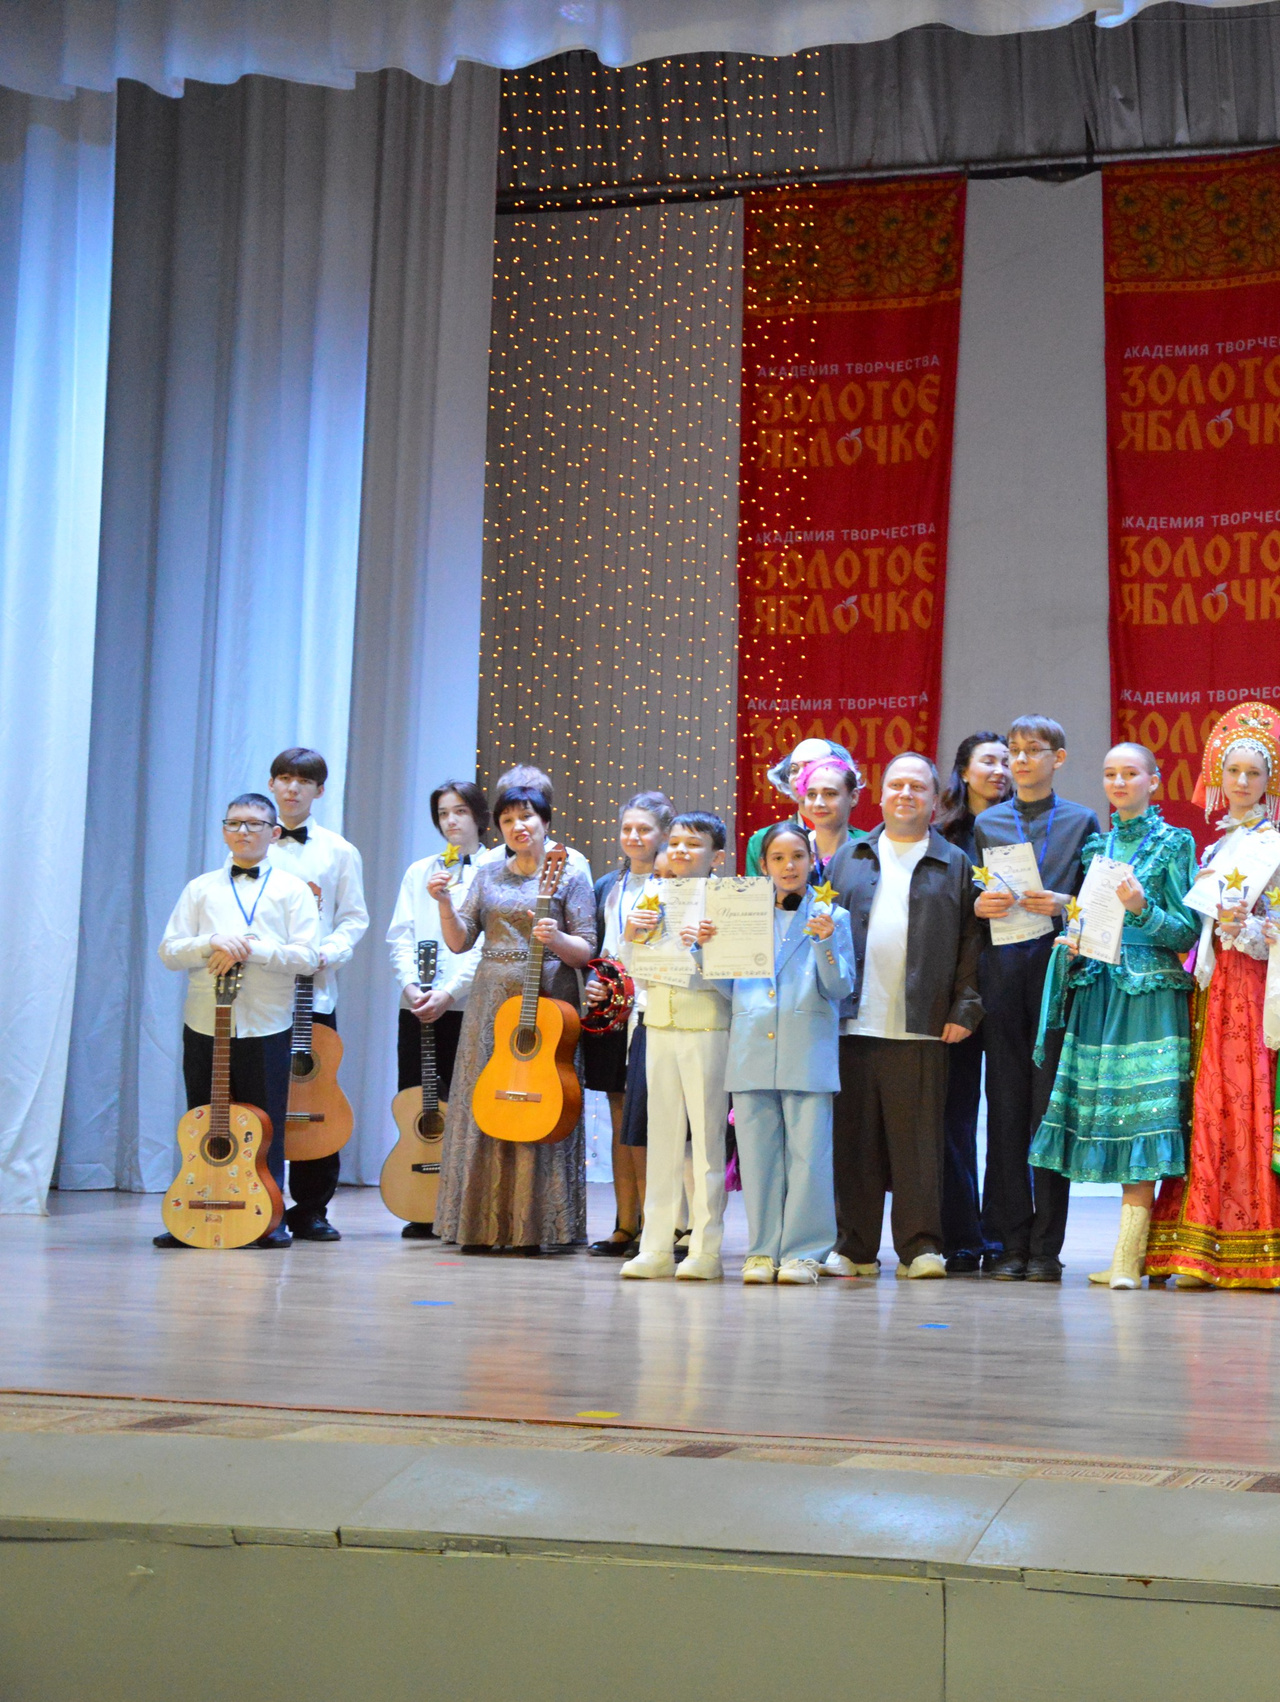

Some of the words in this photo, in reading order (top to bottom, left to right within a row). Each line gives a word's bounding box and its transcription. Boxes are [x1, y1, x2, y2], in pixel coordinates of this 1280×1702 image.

[757, 364, 839, 378] АКАДЕМИЯ
[845, 355, 940, 375] ТВОРЧЕСТВА
[1124, 344, 1209, 359] АКАДЕМИЯ
[756, 373, 941, 424] ЗОЛОТОЕ
[756, 419, 940, 468] ЯБЛОЧКО
[755, 530, 835, 544] АКАДЕМИЯ
[841, 523, 936, 541] ТВОРЧЕСТВА
[754, 541, 937, 590] ЗОЛОТОЕ
[751, 588, 934, 635] ЯБЛОЧКО
[747, 698, 832, 713] АКАДЕМИЯ
[838, 691, 929, 710] ТВОРЧЕСТА
